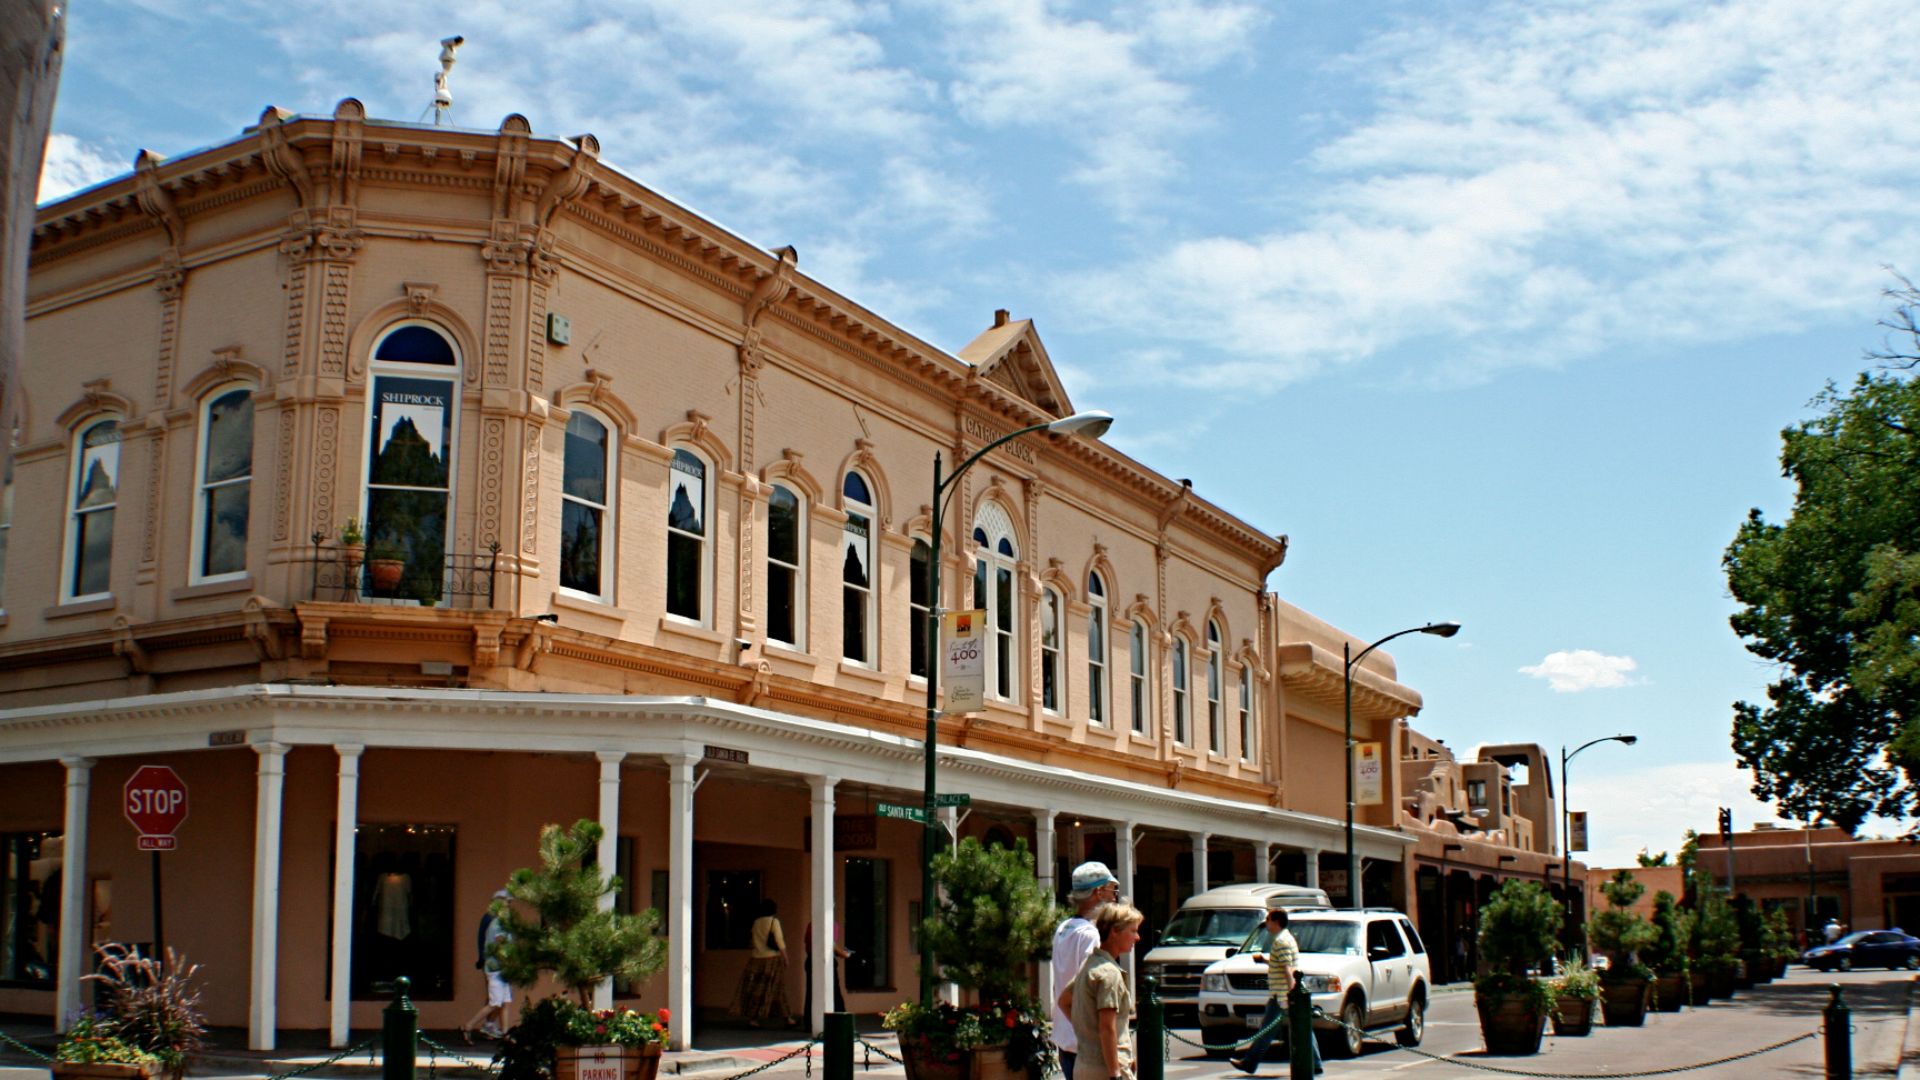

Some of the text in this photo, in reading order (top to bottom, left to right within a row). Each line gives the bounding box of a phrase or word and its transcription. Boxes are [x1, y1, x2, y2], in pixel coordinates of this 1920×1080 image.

[382, 392, 444, 405] SHIPROCK
[129, 789, 183, 814] STOP
[887, 805, 904, 818] SANTA
[905, 807, 912, 820] FE
[142, 839, 154, 847] ALL
[594, 1052, 605, 1064] NO
[582, 1069, 617, 1080] PARKING
